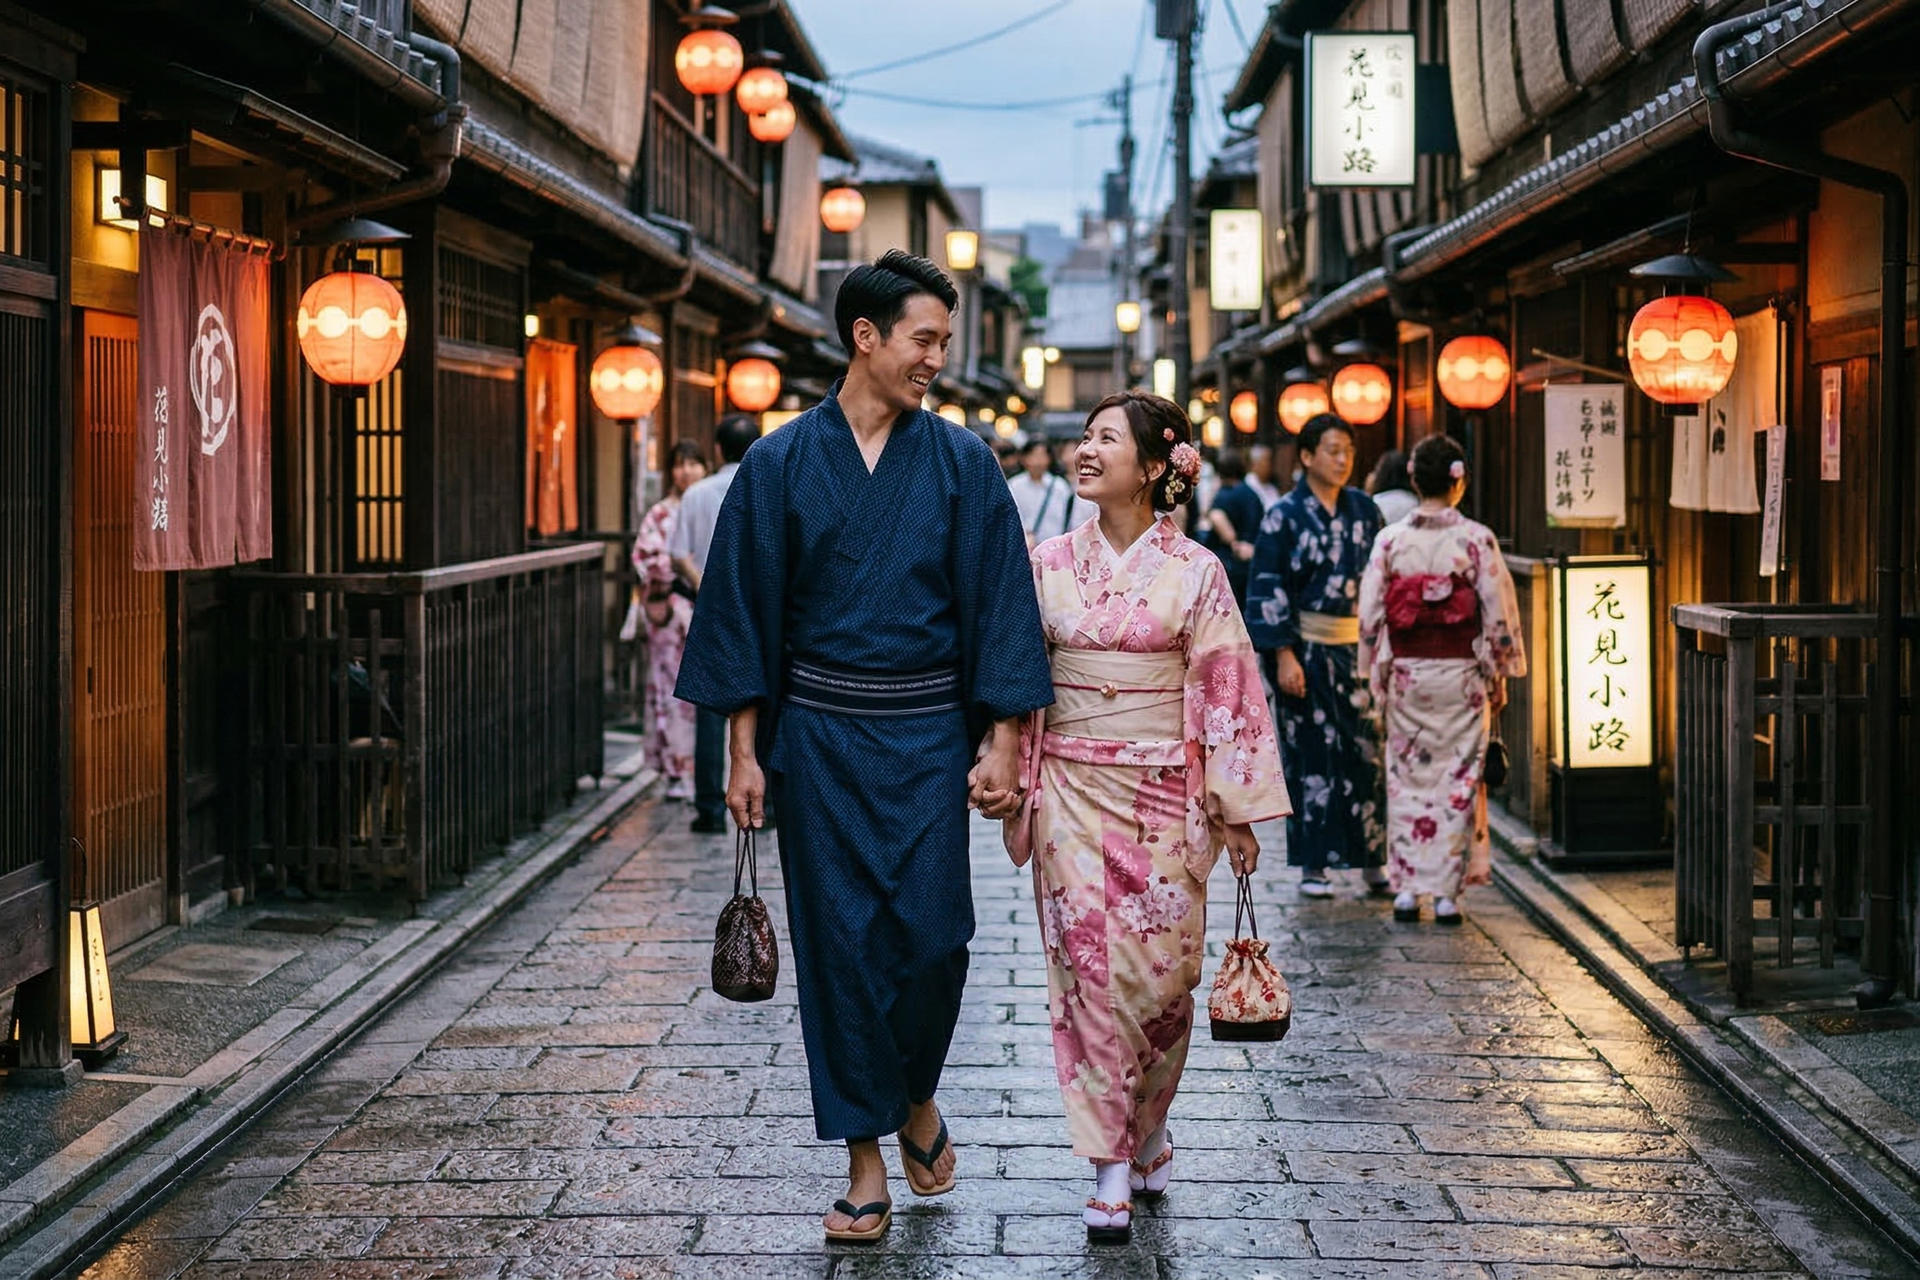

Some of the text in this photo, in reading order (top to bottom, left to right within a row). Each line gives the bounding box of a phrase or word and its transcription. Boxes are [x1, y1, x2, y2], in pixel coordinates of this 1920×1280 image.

[1343, 48, 1377, 173] 花見小路
[1587, 581, 1630, 751] 花見小路
